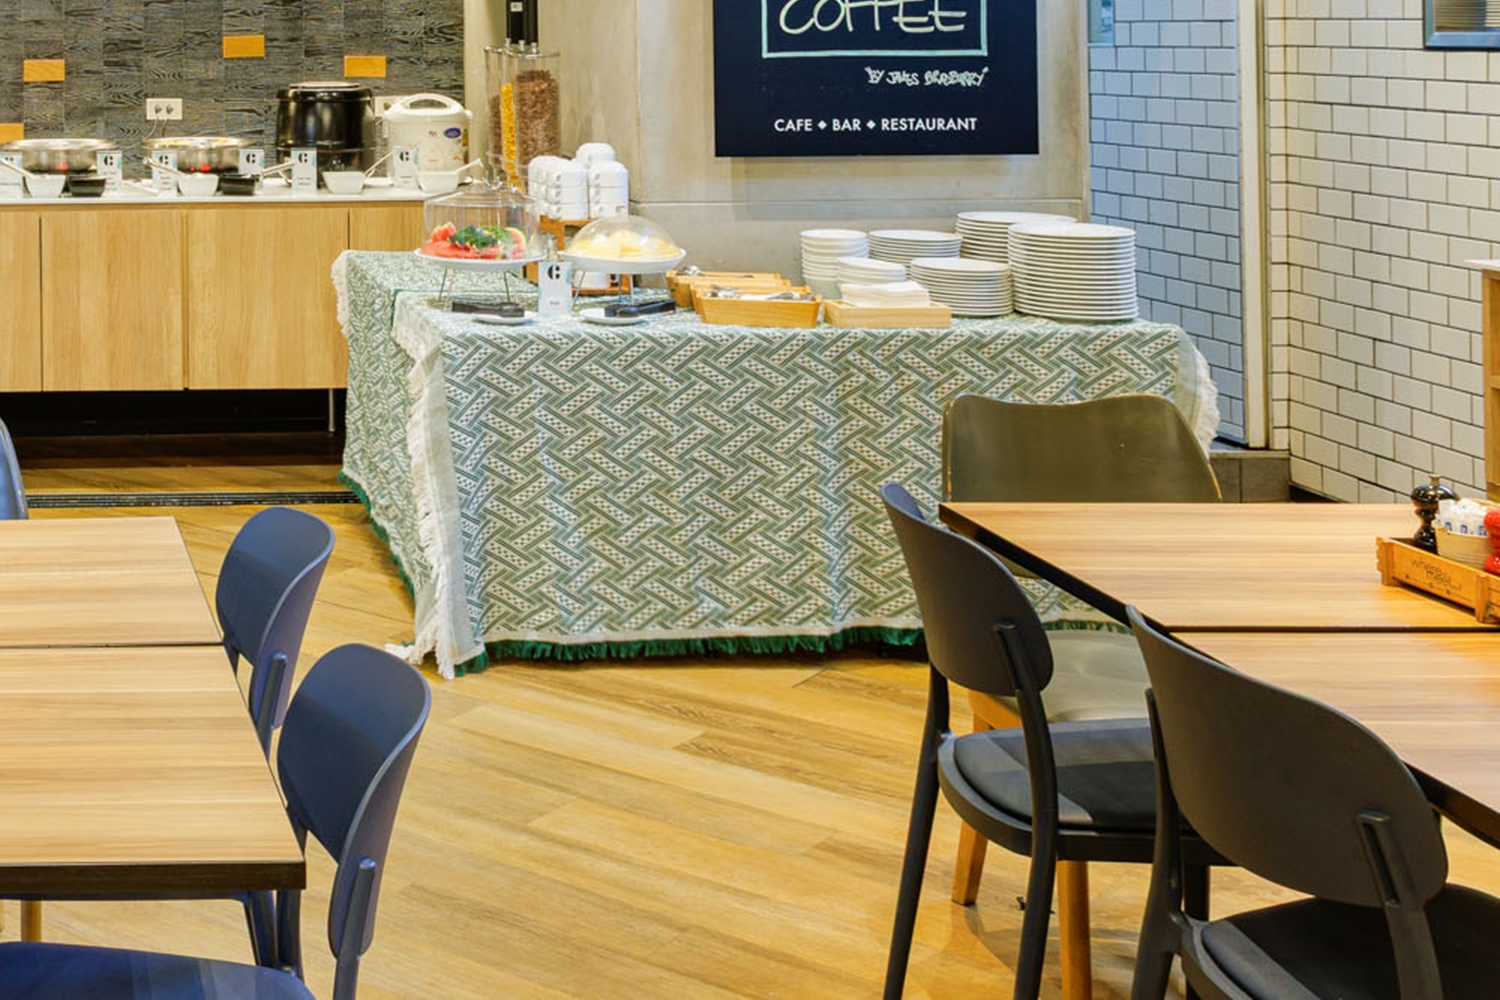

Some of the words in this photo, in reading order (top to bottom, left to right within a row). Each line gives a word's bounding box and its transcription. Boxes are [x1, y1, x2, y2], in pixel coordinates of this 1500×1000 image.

[774, 118, 813, 132] CAFE
[832, 118, 861, 131] BAR
[881, 117, 977, 131] RESTAURANT
